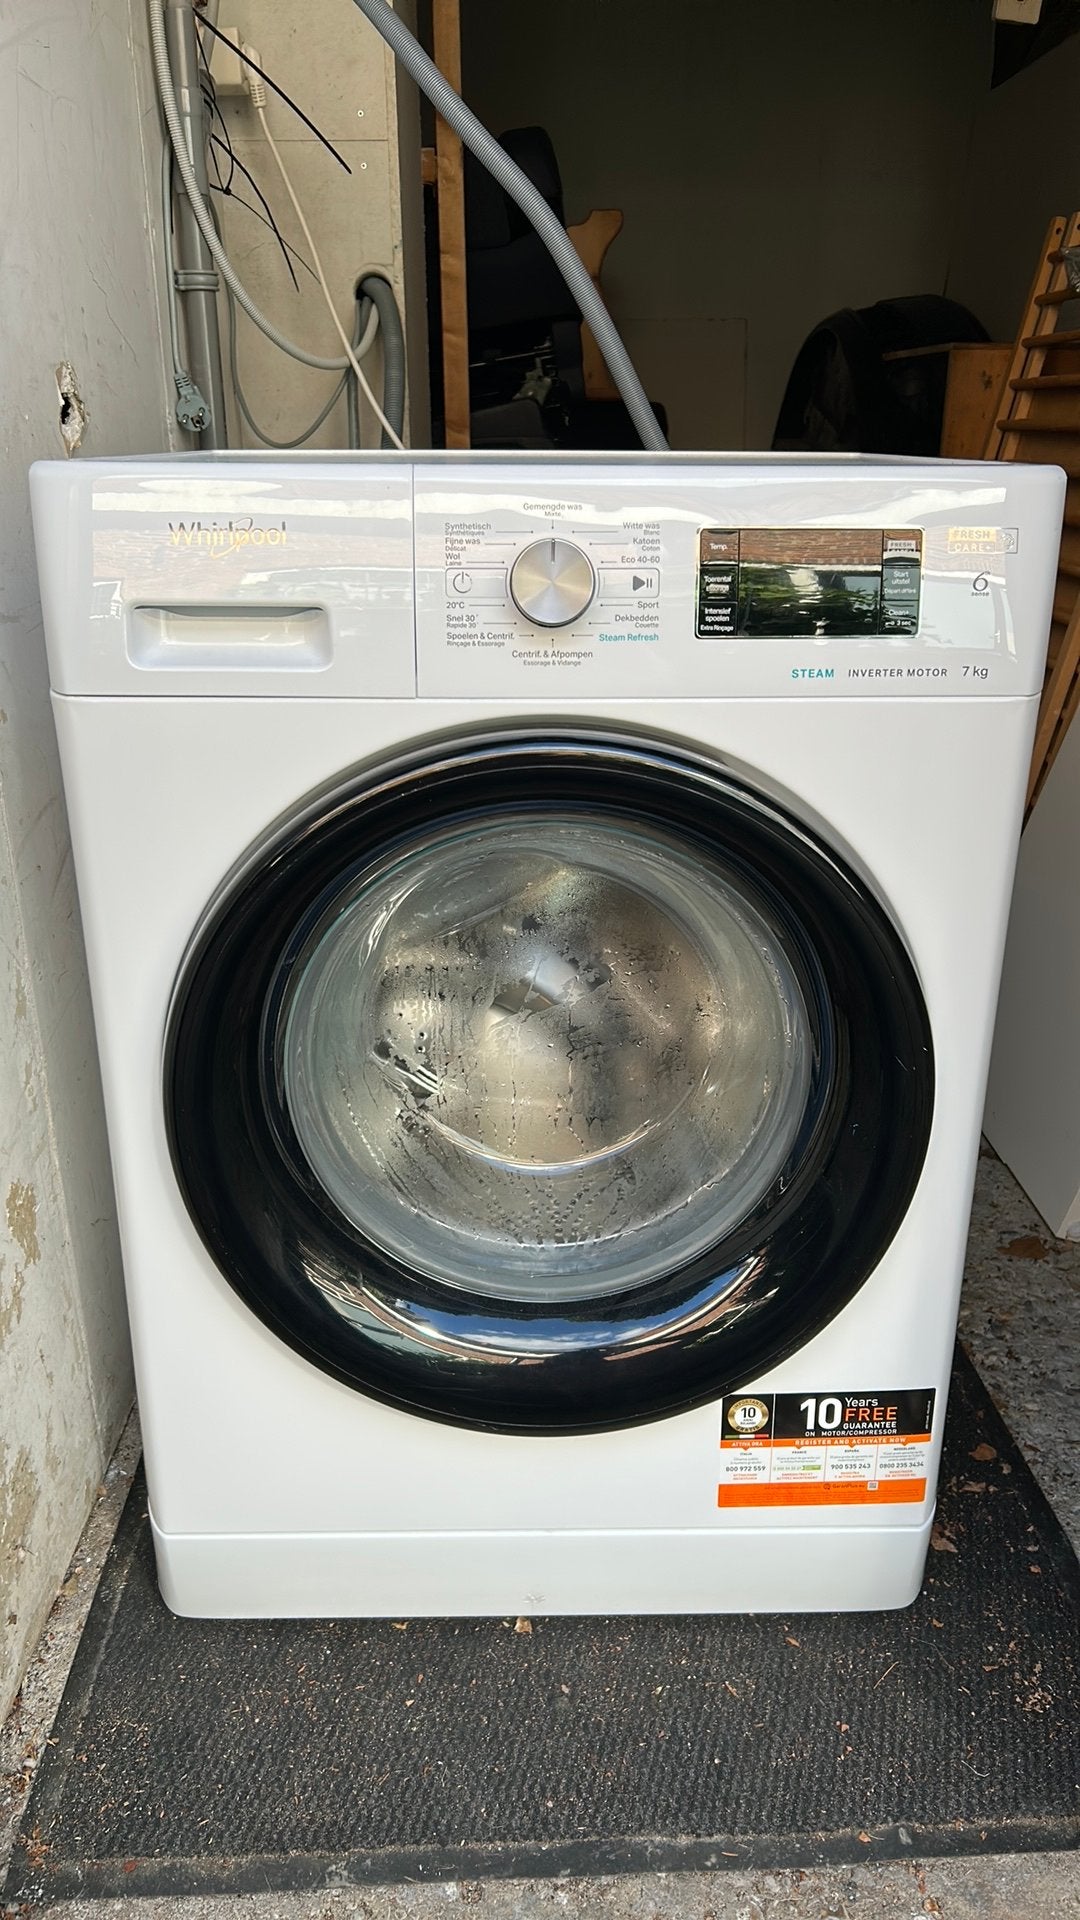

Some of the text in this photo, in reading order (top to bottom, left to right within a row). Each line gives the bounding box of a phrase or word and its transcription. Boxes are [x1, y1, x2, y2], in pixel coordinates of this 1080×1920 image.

[523, 502, 566, 511] Gemengde
[445, 522, 491, 531] Synthetisch
[168, 517, 287, 559] Whirlpool
[954, 530, 990, 539] FRESH
[445, 537, 464, 546] Fijne
[955, 543, 991, 552] CARE+
[973, 571, 990, 591] 6
[638, 601, 659, 610] Sport
[447, 632, 478, 640] Spoelen
[551, 650, 593, 659] Afpompen
[792, 668, 834, 678] STEAM
[848, 668, 947, 677] INVERTER MOTOR
[962, 666, 988, 679] 7 kg
[845, 1397, 878, 1407] Years
[741, 1407, 756, 1418] 10
[800, 1398, 842, 1430] 10
[845, 1407, 897, 1421] FREE
